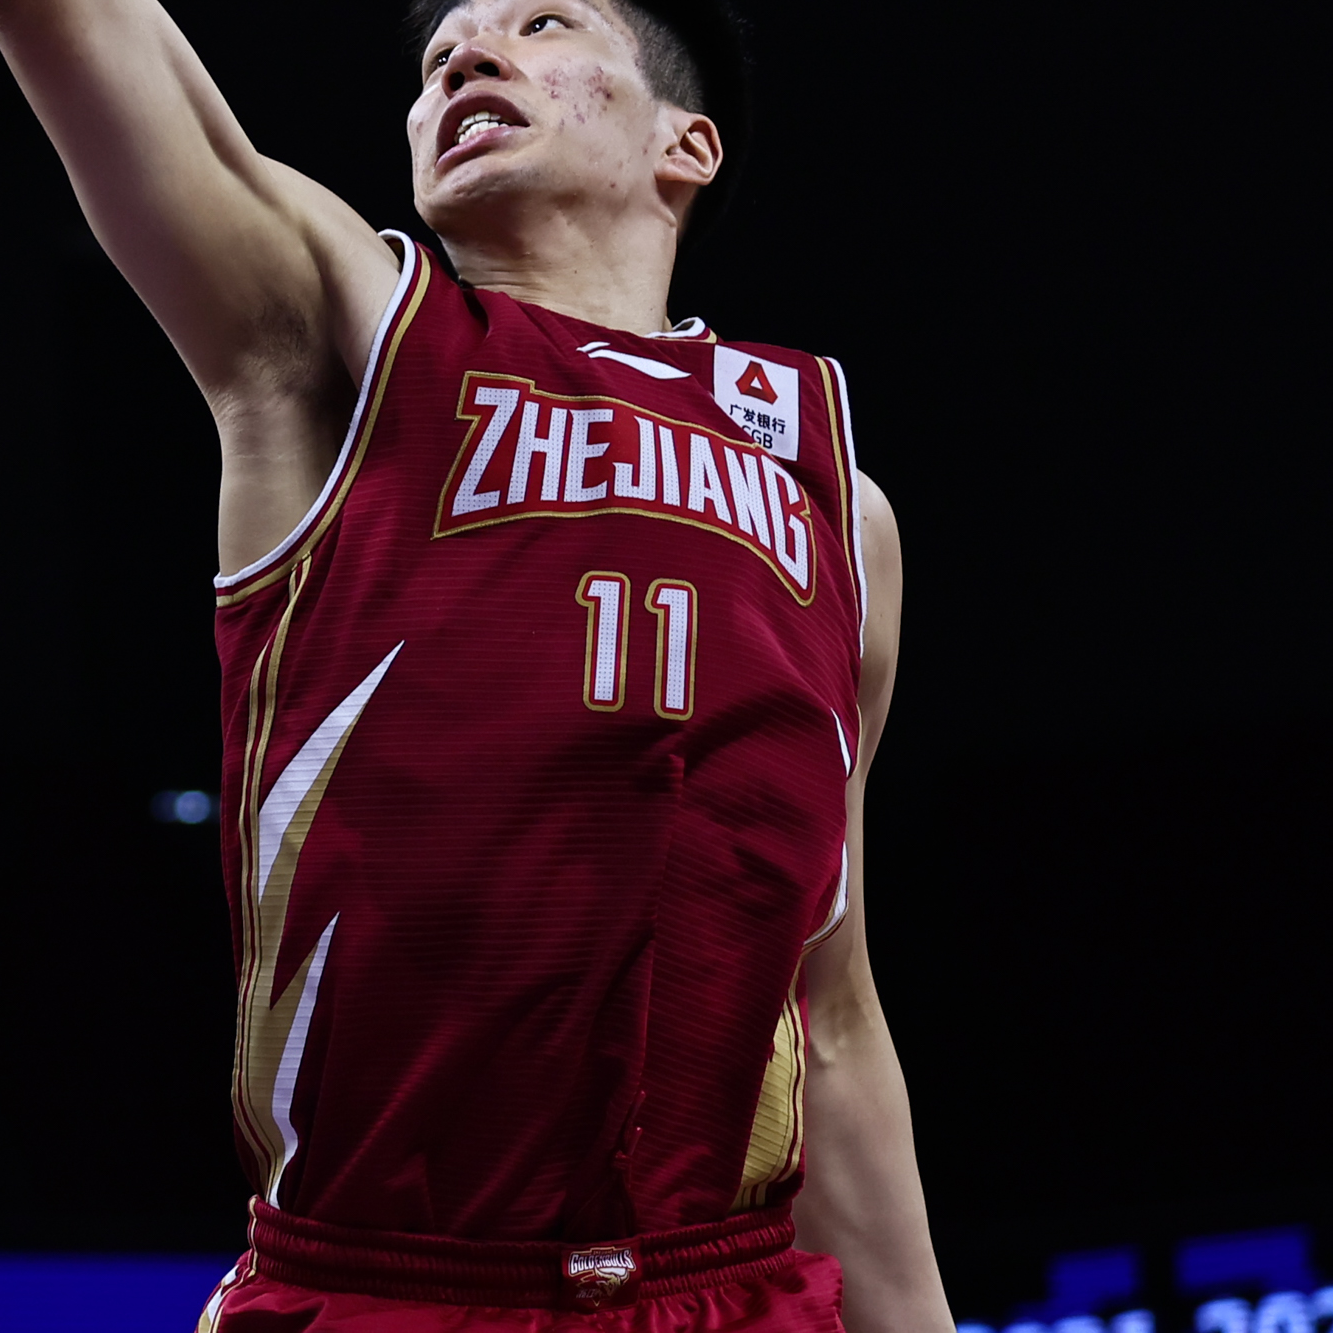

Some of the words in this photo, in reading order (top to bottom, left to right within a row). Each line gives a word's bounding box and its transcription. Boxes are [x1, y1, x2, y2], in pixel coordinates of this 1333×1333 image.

[450, 386, 810, 592] ZHEJIANG
[730, 404, 785, 435] 广发银行
[580, 573, 695, 717] 11
